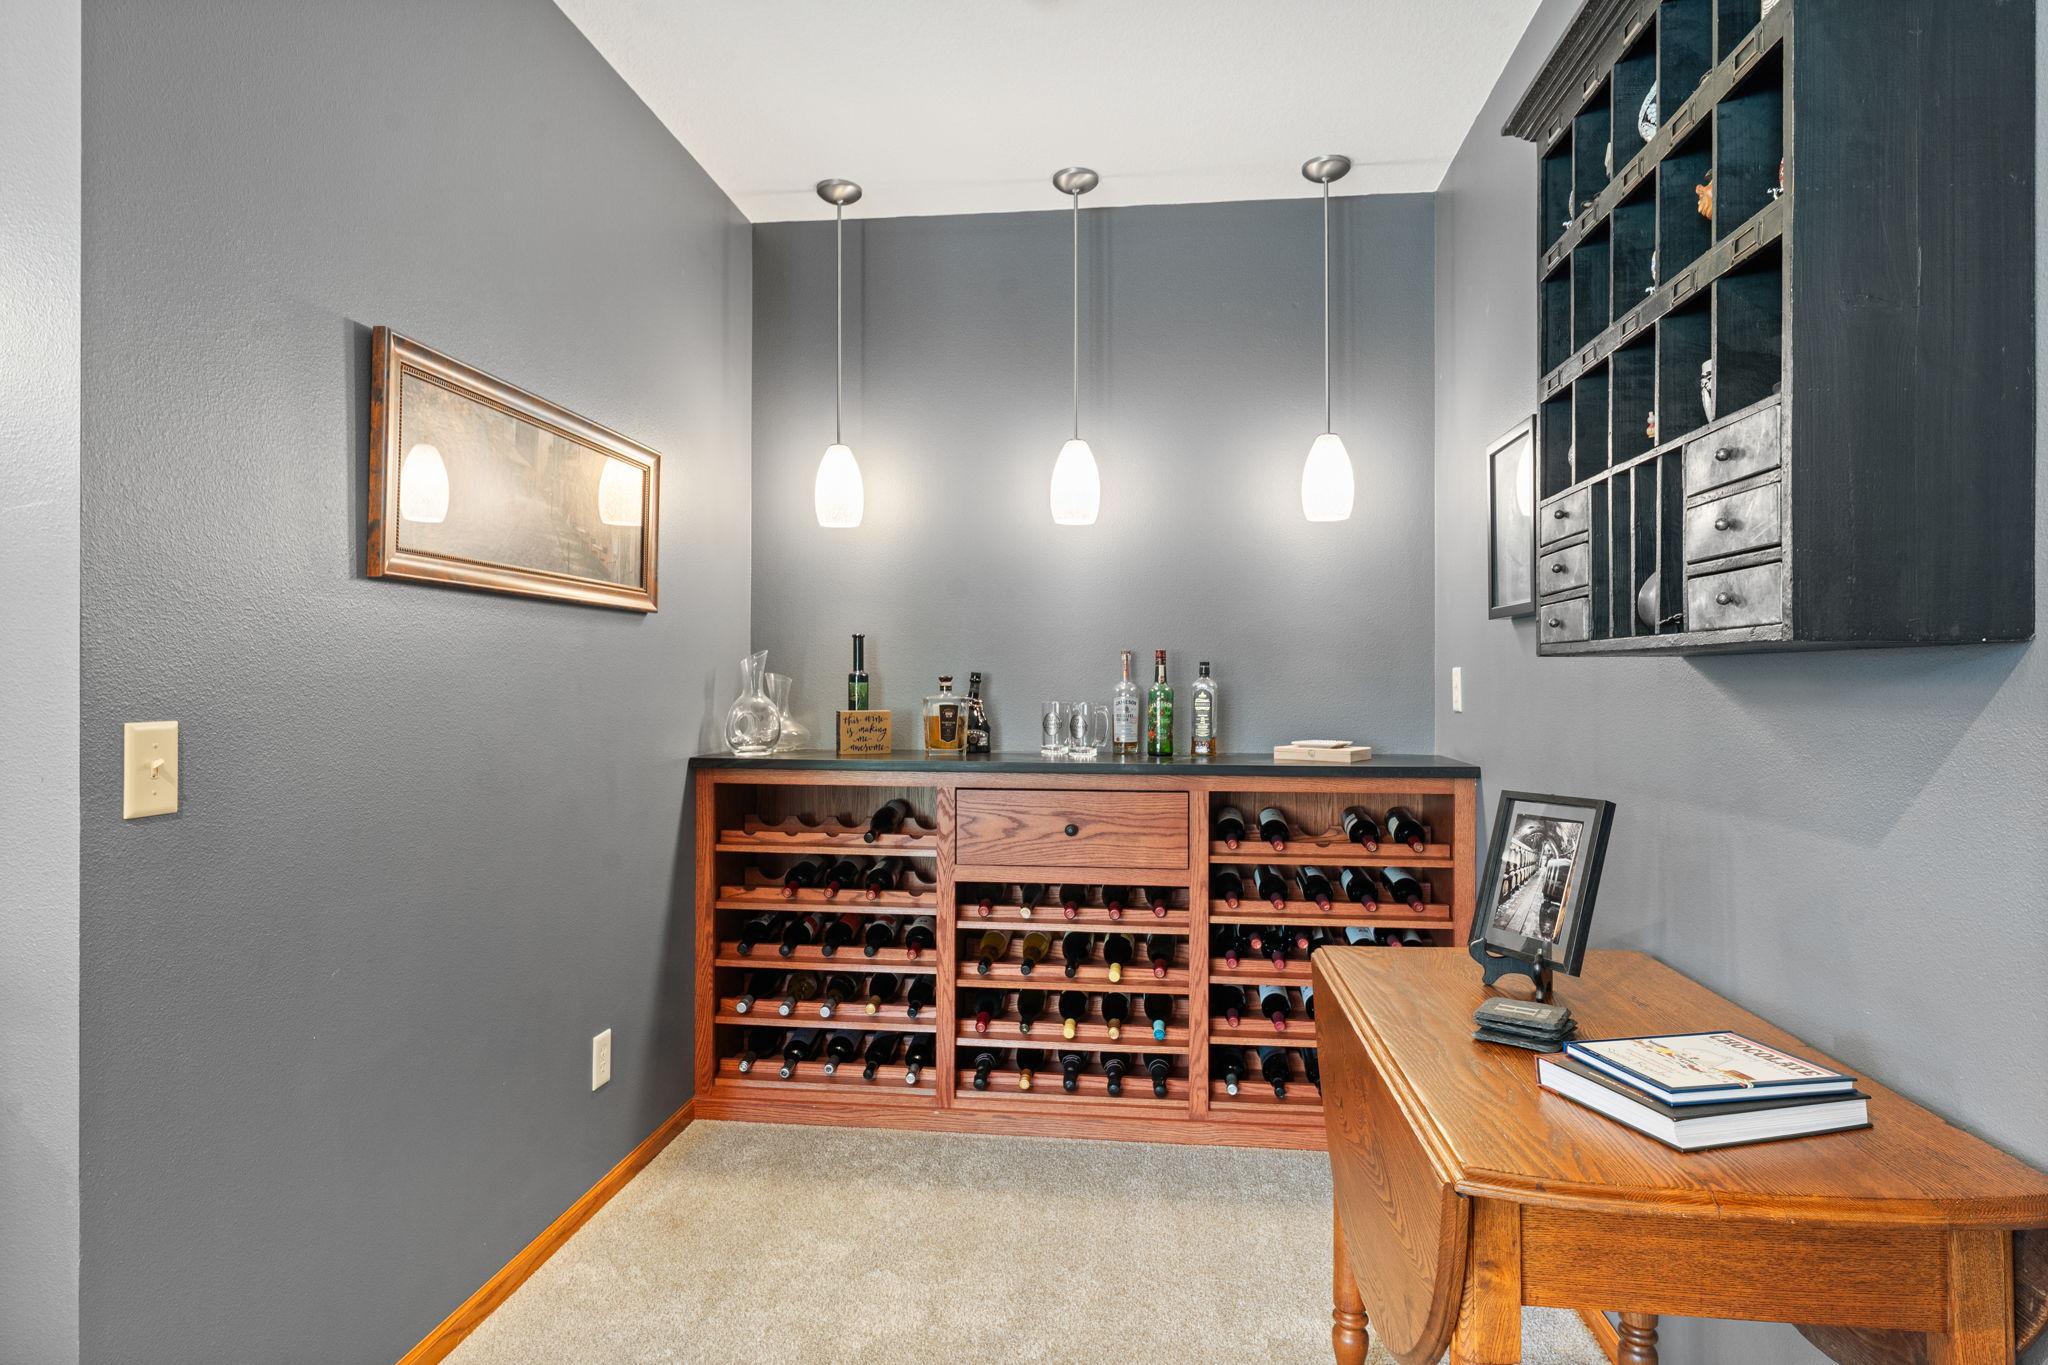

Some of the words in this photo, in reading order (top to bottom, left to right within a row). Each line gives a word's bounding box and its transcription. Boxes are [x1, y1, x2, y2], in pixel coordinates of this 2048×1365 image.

[843, 714, 860, 726] this
[865, 715, 885, 723] wine
[847, 727, 853, 737] is
[858, 723, 887, 741] making
[849, 743, 885, 752] awesome
[1708, 1034, 1823, 1078] CHOCOLATE
